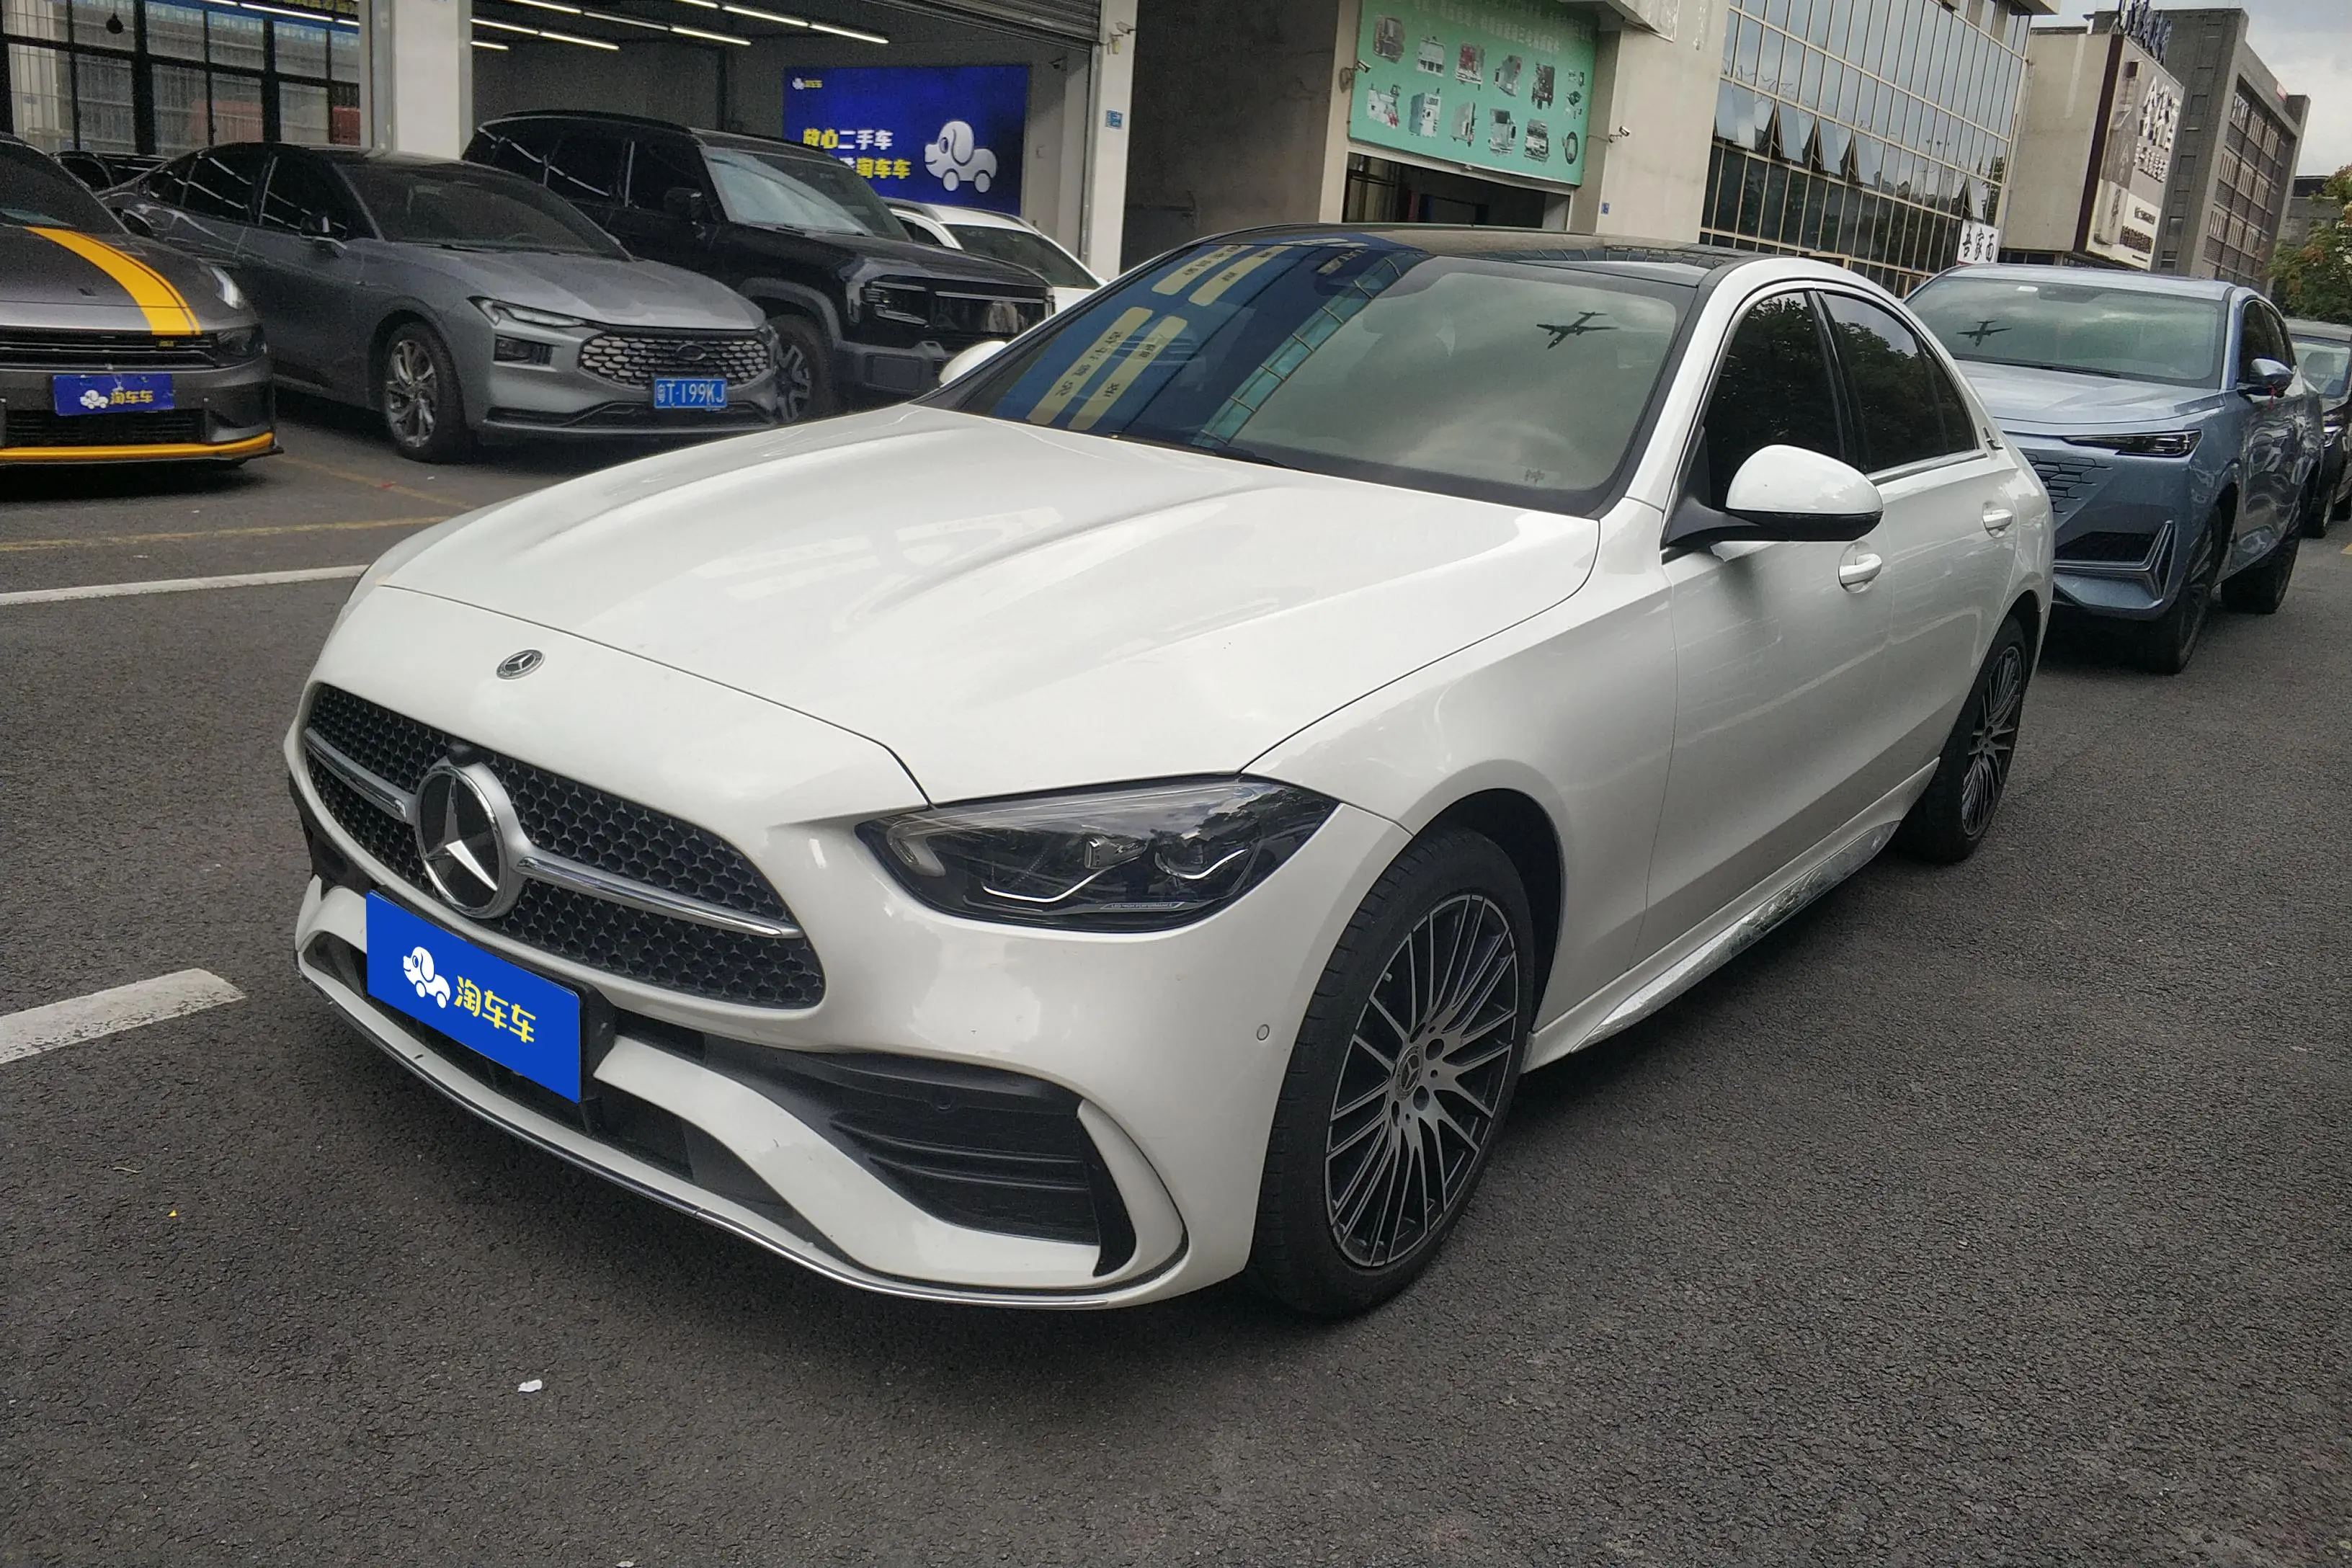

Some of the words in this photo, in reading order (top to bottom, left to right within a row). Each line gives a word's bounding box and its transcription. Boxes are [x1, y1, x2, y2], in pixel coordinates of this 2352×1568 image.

[803, 128, 894, 150] 放心二手车
[110, 390, 153, 405] 淘车车
